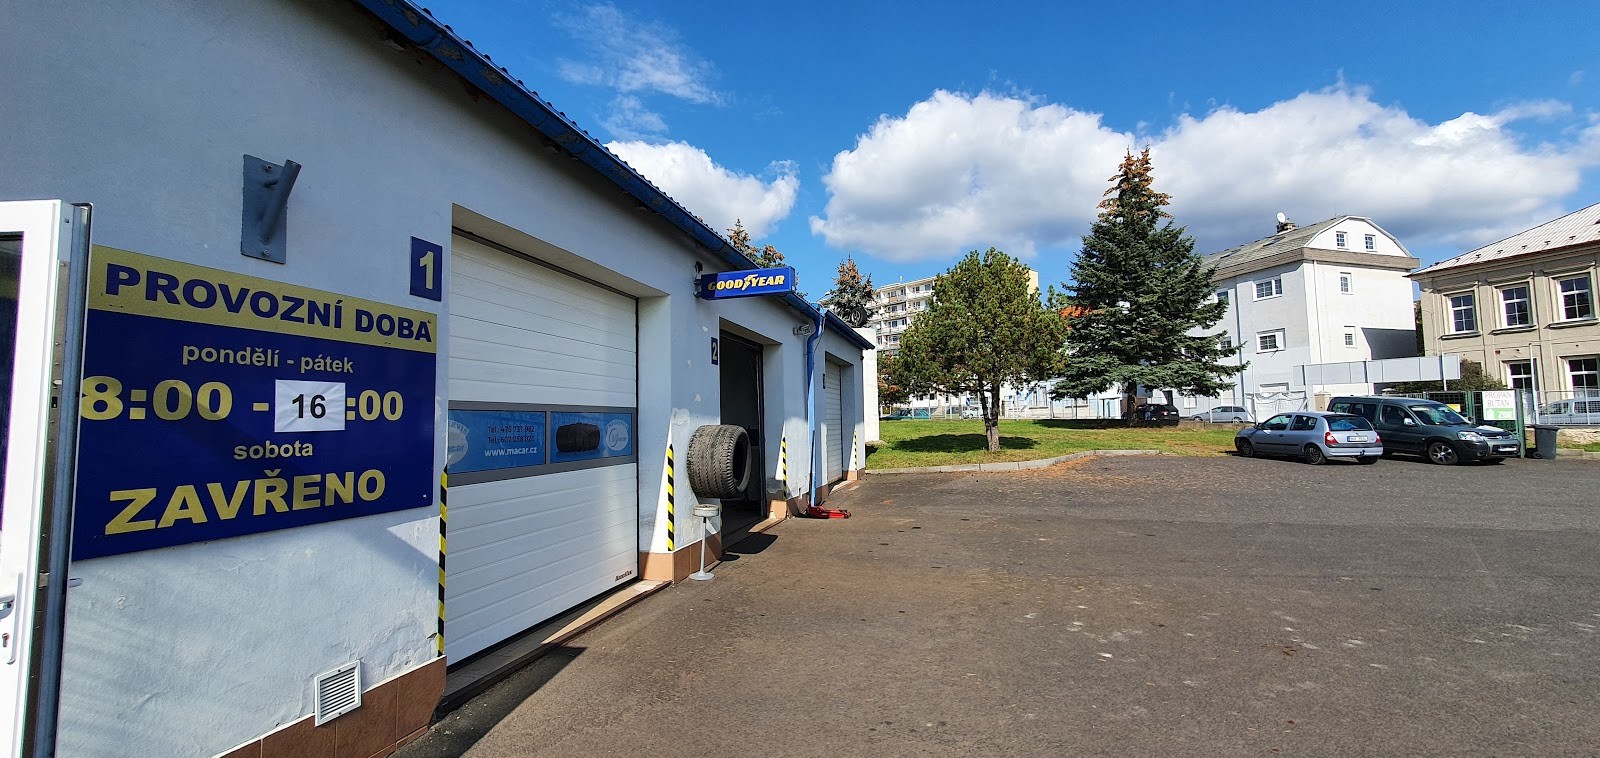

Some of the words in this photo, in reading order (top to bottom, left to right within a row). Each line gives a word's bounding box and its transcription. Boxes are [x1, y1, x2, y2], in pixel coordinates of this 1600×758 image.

[419, 250, 434, 290] 1
[707, 273, 785, 291] GOODYEAR
[105, 263, 343, 329] PROVOZNÍ
[355, 308, 432, 342] DOBA
[182, 344, 280, 367] pondělí
[300, 354, 354, 373] pátek
[712, 342, 718, 361] 2
[80, 375, 233, 421] 8:00
[252, 402, 270, 412] -
[1484, 391, 1512, 399] PROPAN
[1487, 399, 1510, 407] BUTAN
[233, 440, 313, 460] sobota
[484, 447, 538, 457] www.macar.cz
[104, 469, 386, 535] ZAVŘENO
